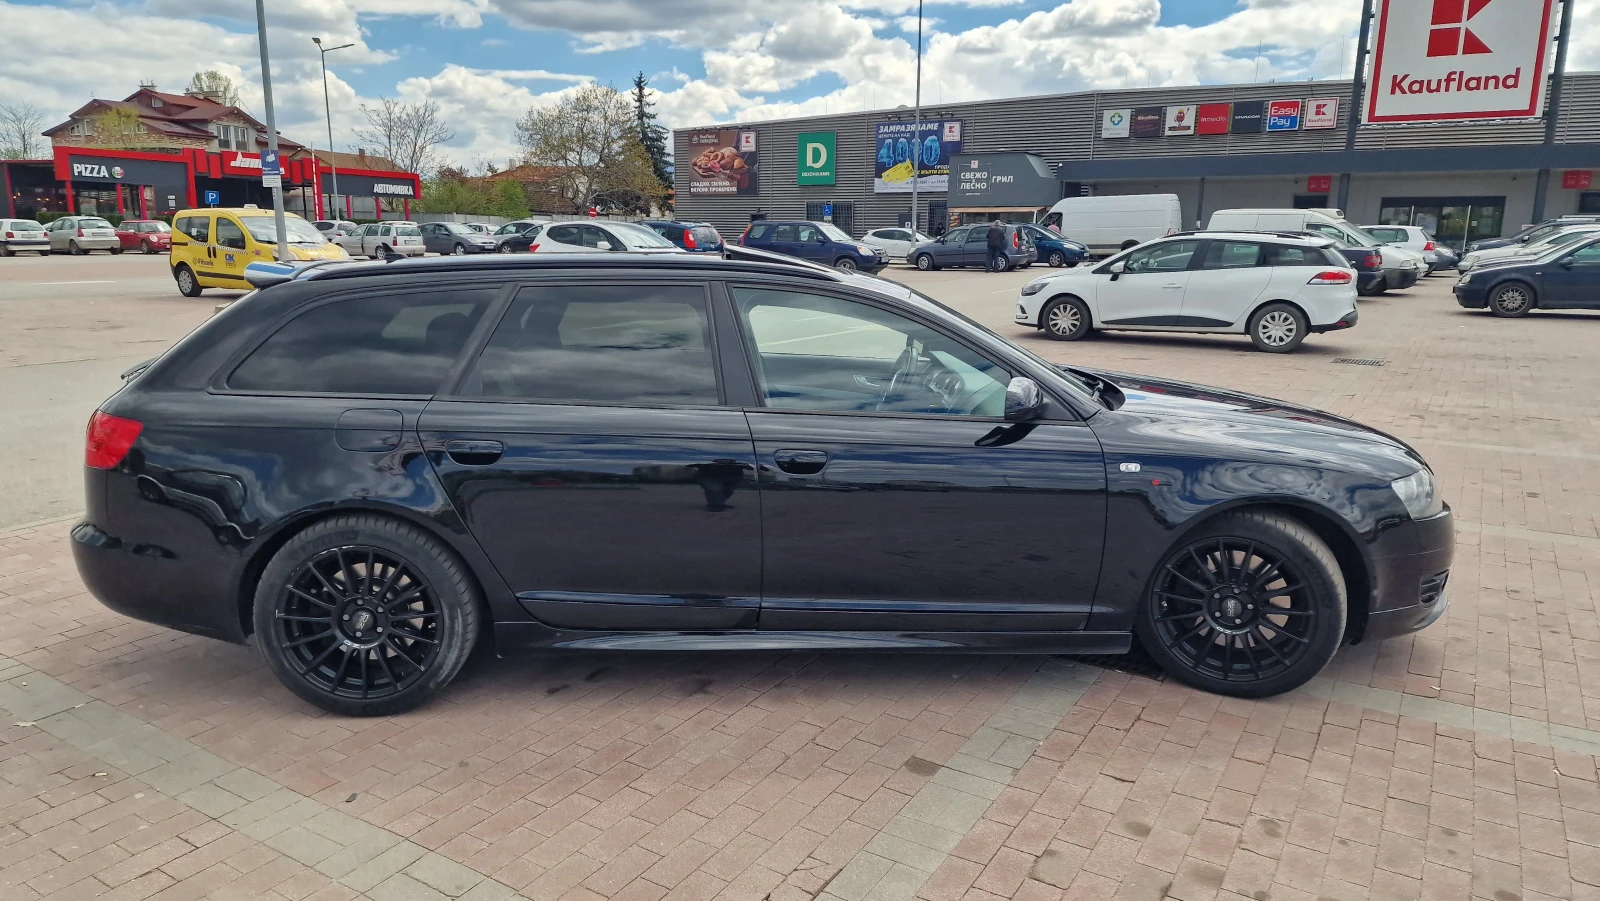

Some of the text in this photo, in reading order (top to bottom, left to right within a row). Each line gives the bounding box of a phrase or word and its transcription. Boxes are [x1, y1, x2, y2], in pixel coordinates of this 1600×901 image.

[1390, 67, 1521, 95] Kaufland
[1271, 106, 1298, 116] Easy
[1270, 117, 1290, 127] Pay
[73, 163, 109, 178] PIZZA
[992, 175, 1013, 183] ГРИЛ
[373, 183, 413, 195] АВТОМИВКА
[208, 193, 216, 202] P
